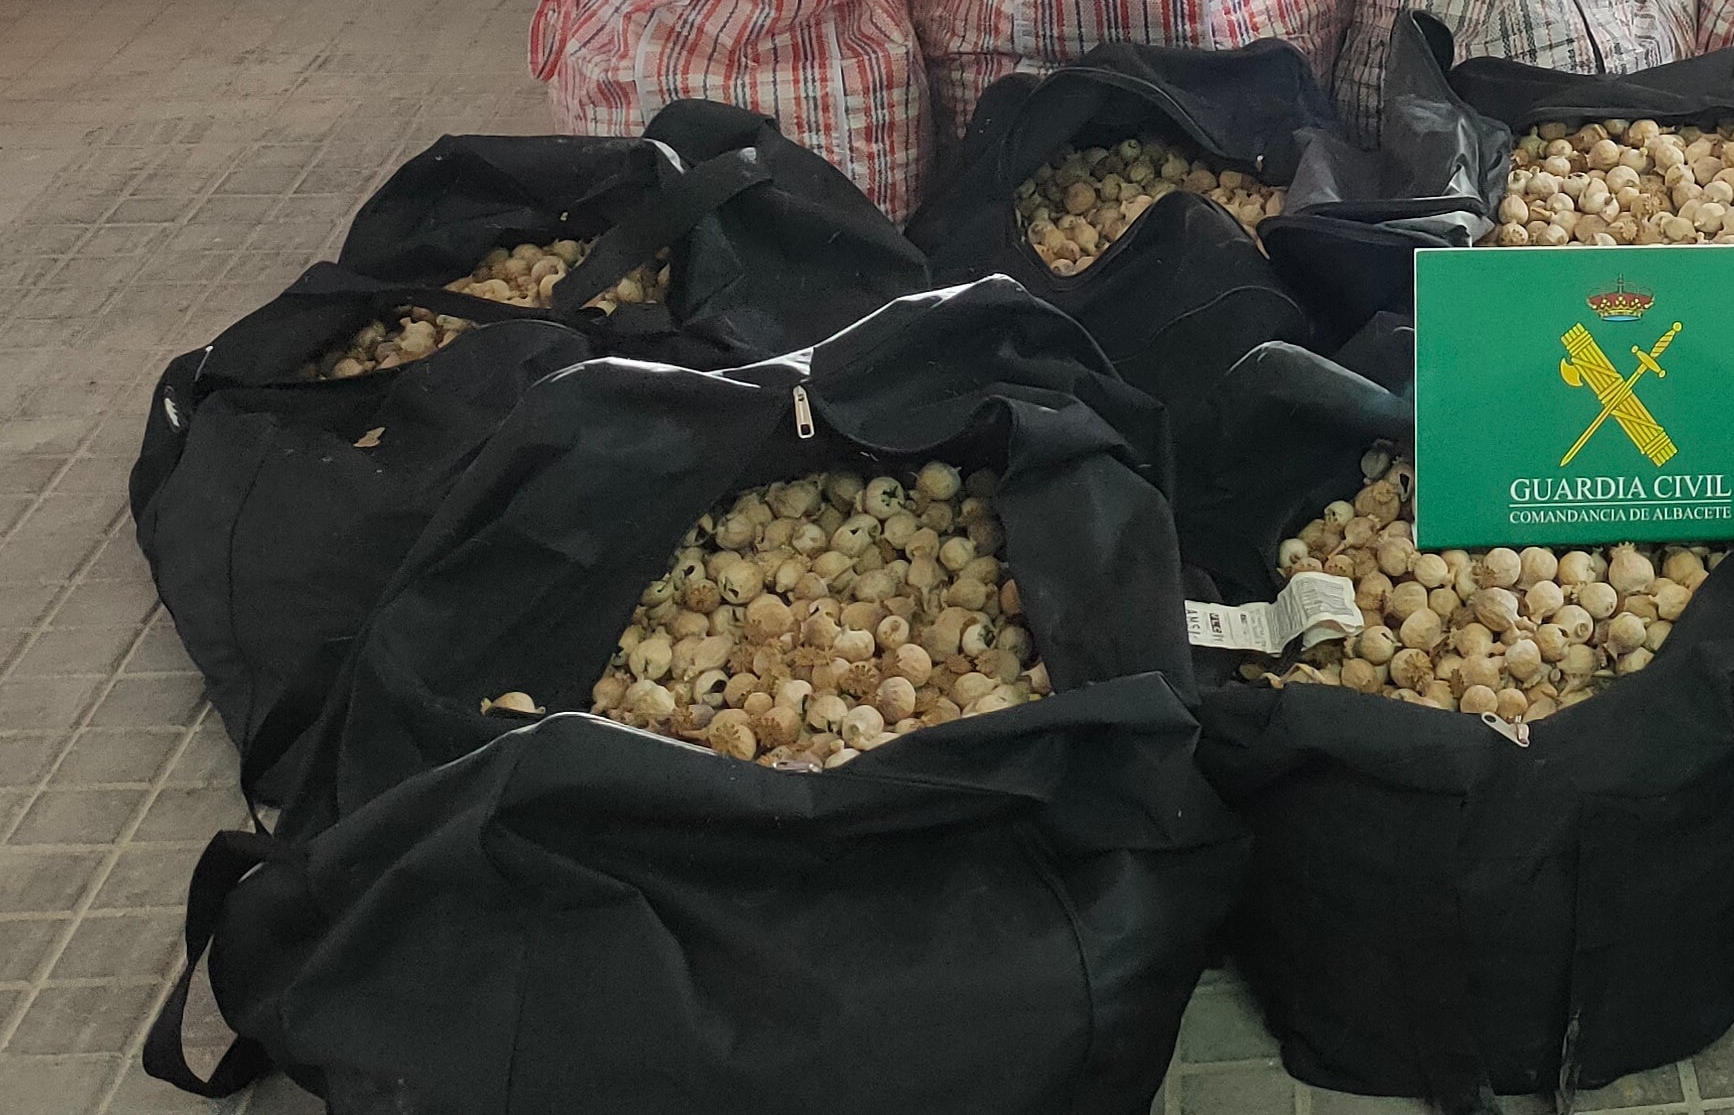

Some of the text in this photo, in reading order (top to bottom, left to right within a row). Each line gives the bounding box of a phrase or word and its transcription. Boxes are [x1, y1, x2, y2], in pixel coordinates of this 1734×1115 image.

[1509, 474, 1732, 502] GUARDIA CIVIL
[1509, 505, 1732, 524] COMANDANCIA DE ALBACETE
